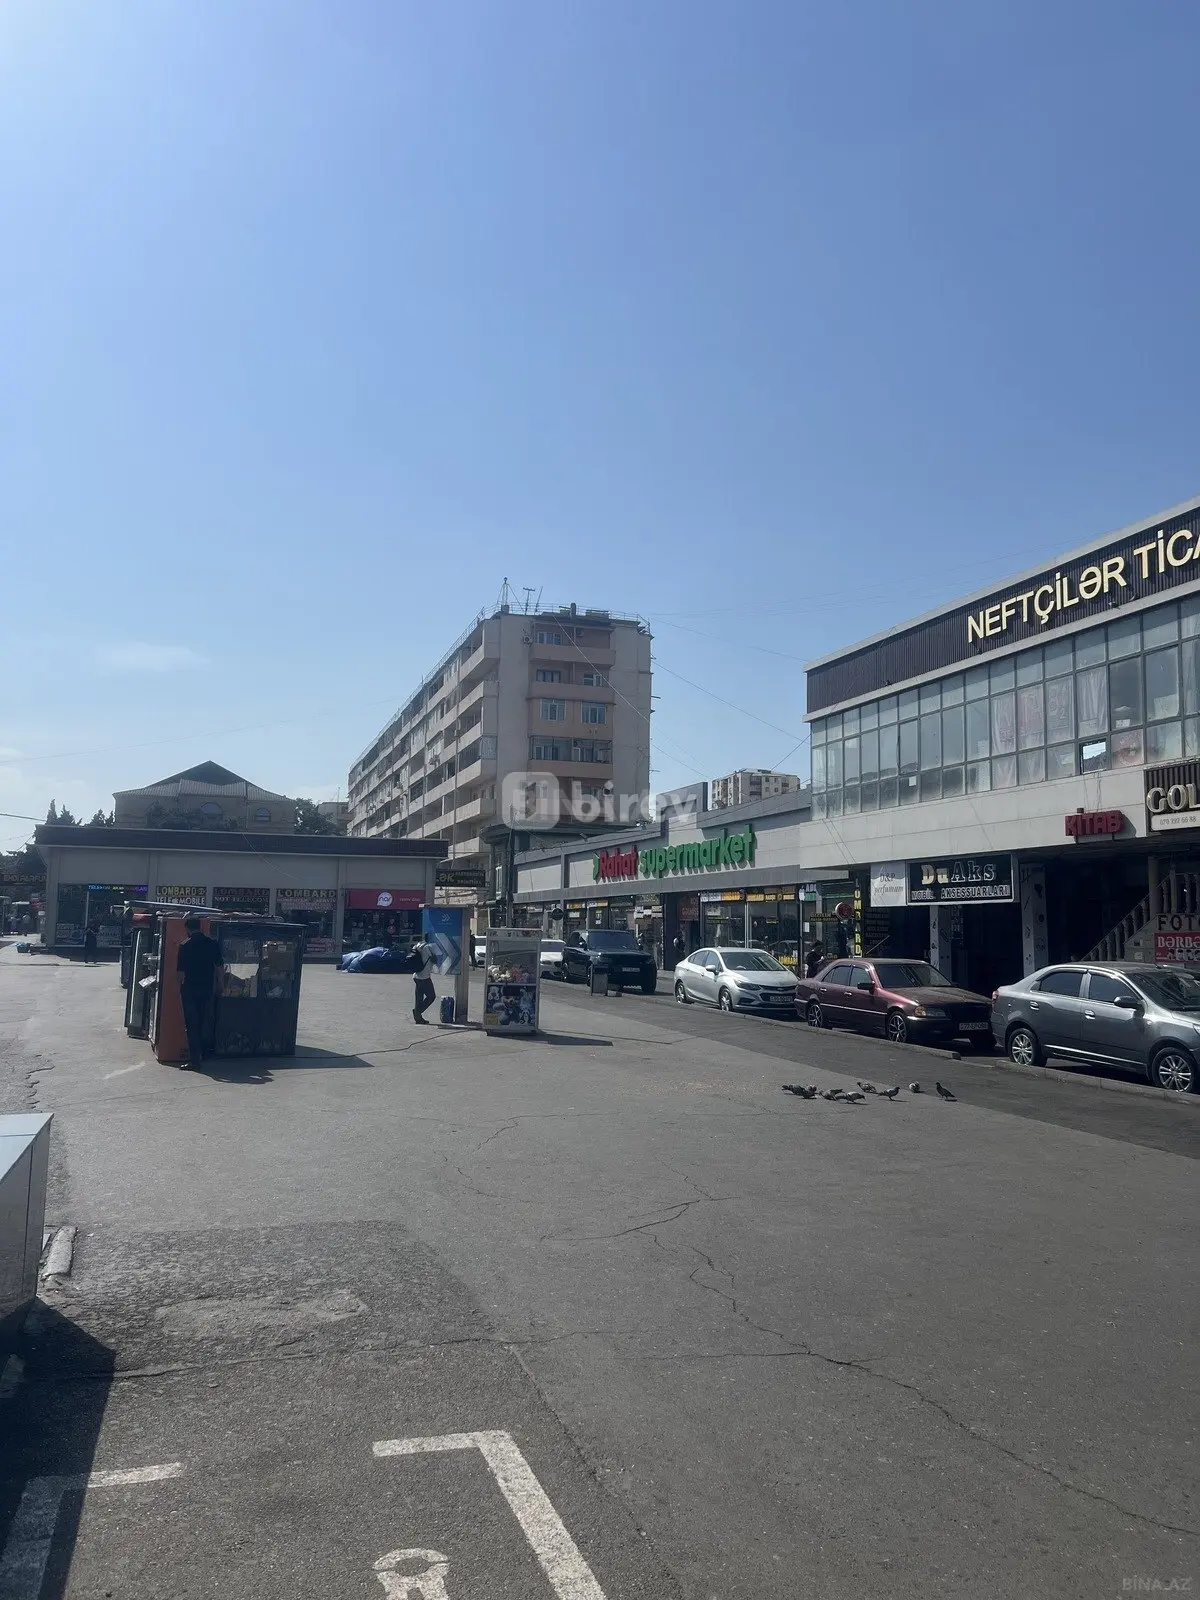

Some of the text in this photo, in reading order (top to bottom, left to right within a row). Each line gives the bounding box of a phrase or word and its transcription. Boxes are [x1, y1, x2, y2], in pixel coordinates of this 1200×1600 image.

[968, 529, 1200, 643] NEFTÇİLƏR TİC
[601, 824, 755, 879] Rahat supermarket
[156, 886, 197, 896] LOMBARD
[277, 889, 336, 898] LOMBARD
[1157, 914, 1200, 931] FOT
